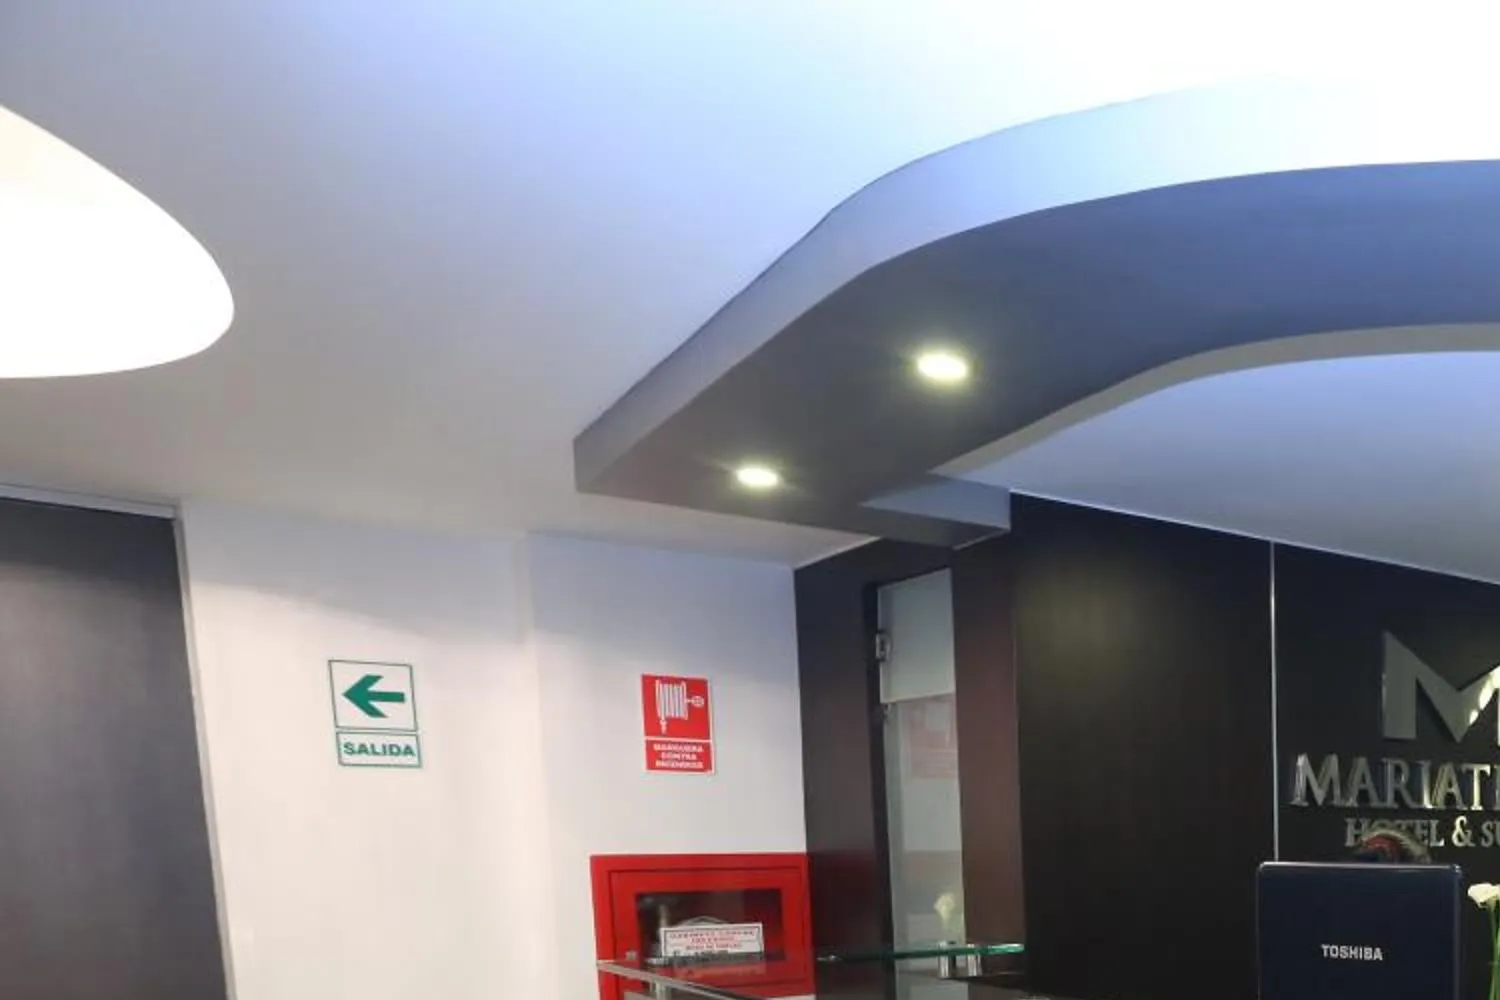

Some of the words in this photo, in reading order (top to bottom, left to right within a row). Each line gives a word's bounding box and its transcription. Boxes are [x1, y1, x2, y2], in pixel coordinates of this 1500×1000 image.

[343, 742, 416, 756] SALIDA
[1452, 815, 1475, 848] &
[1321, 944, 1382, 960] TOSHIBA
